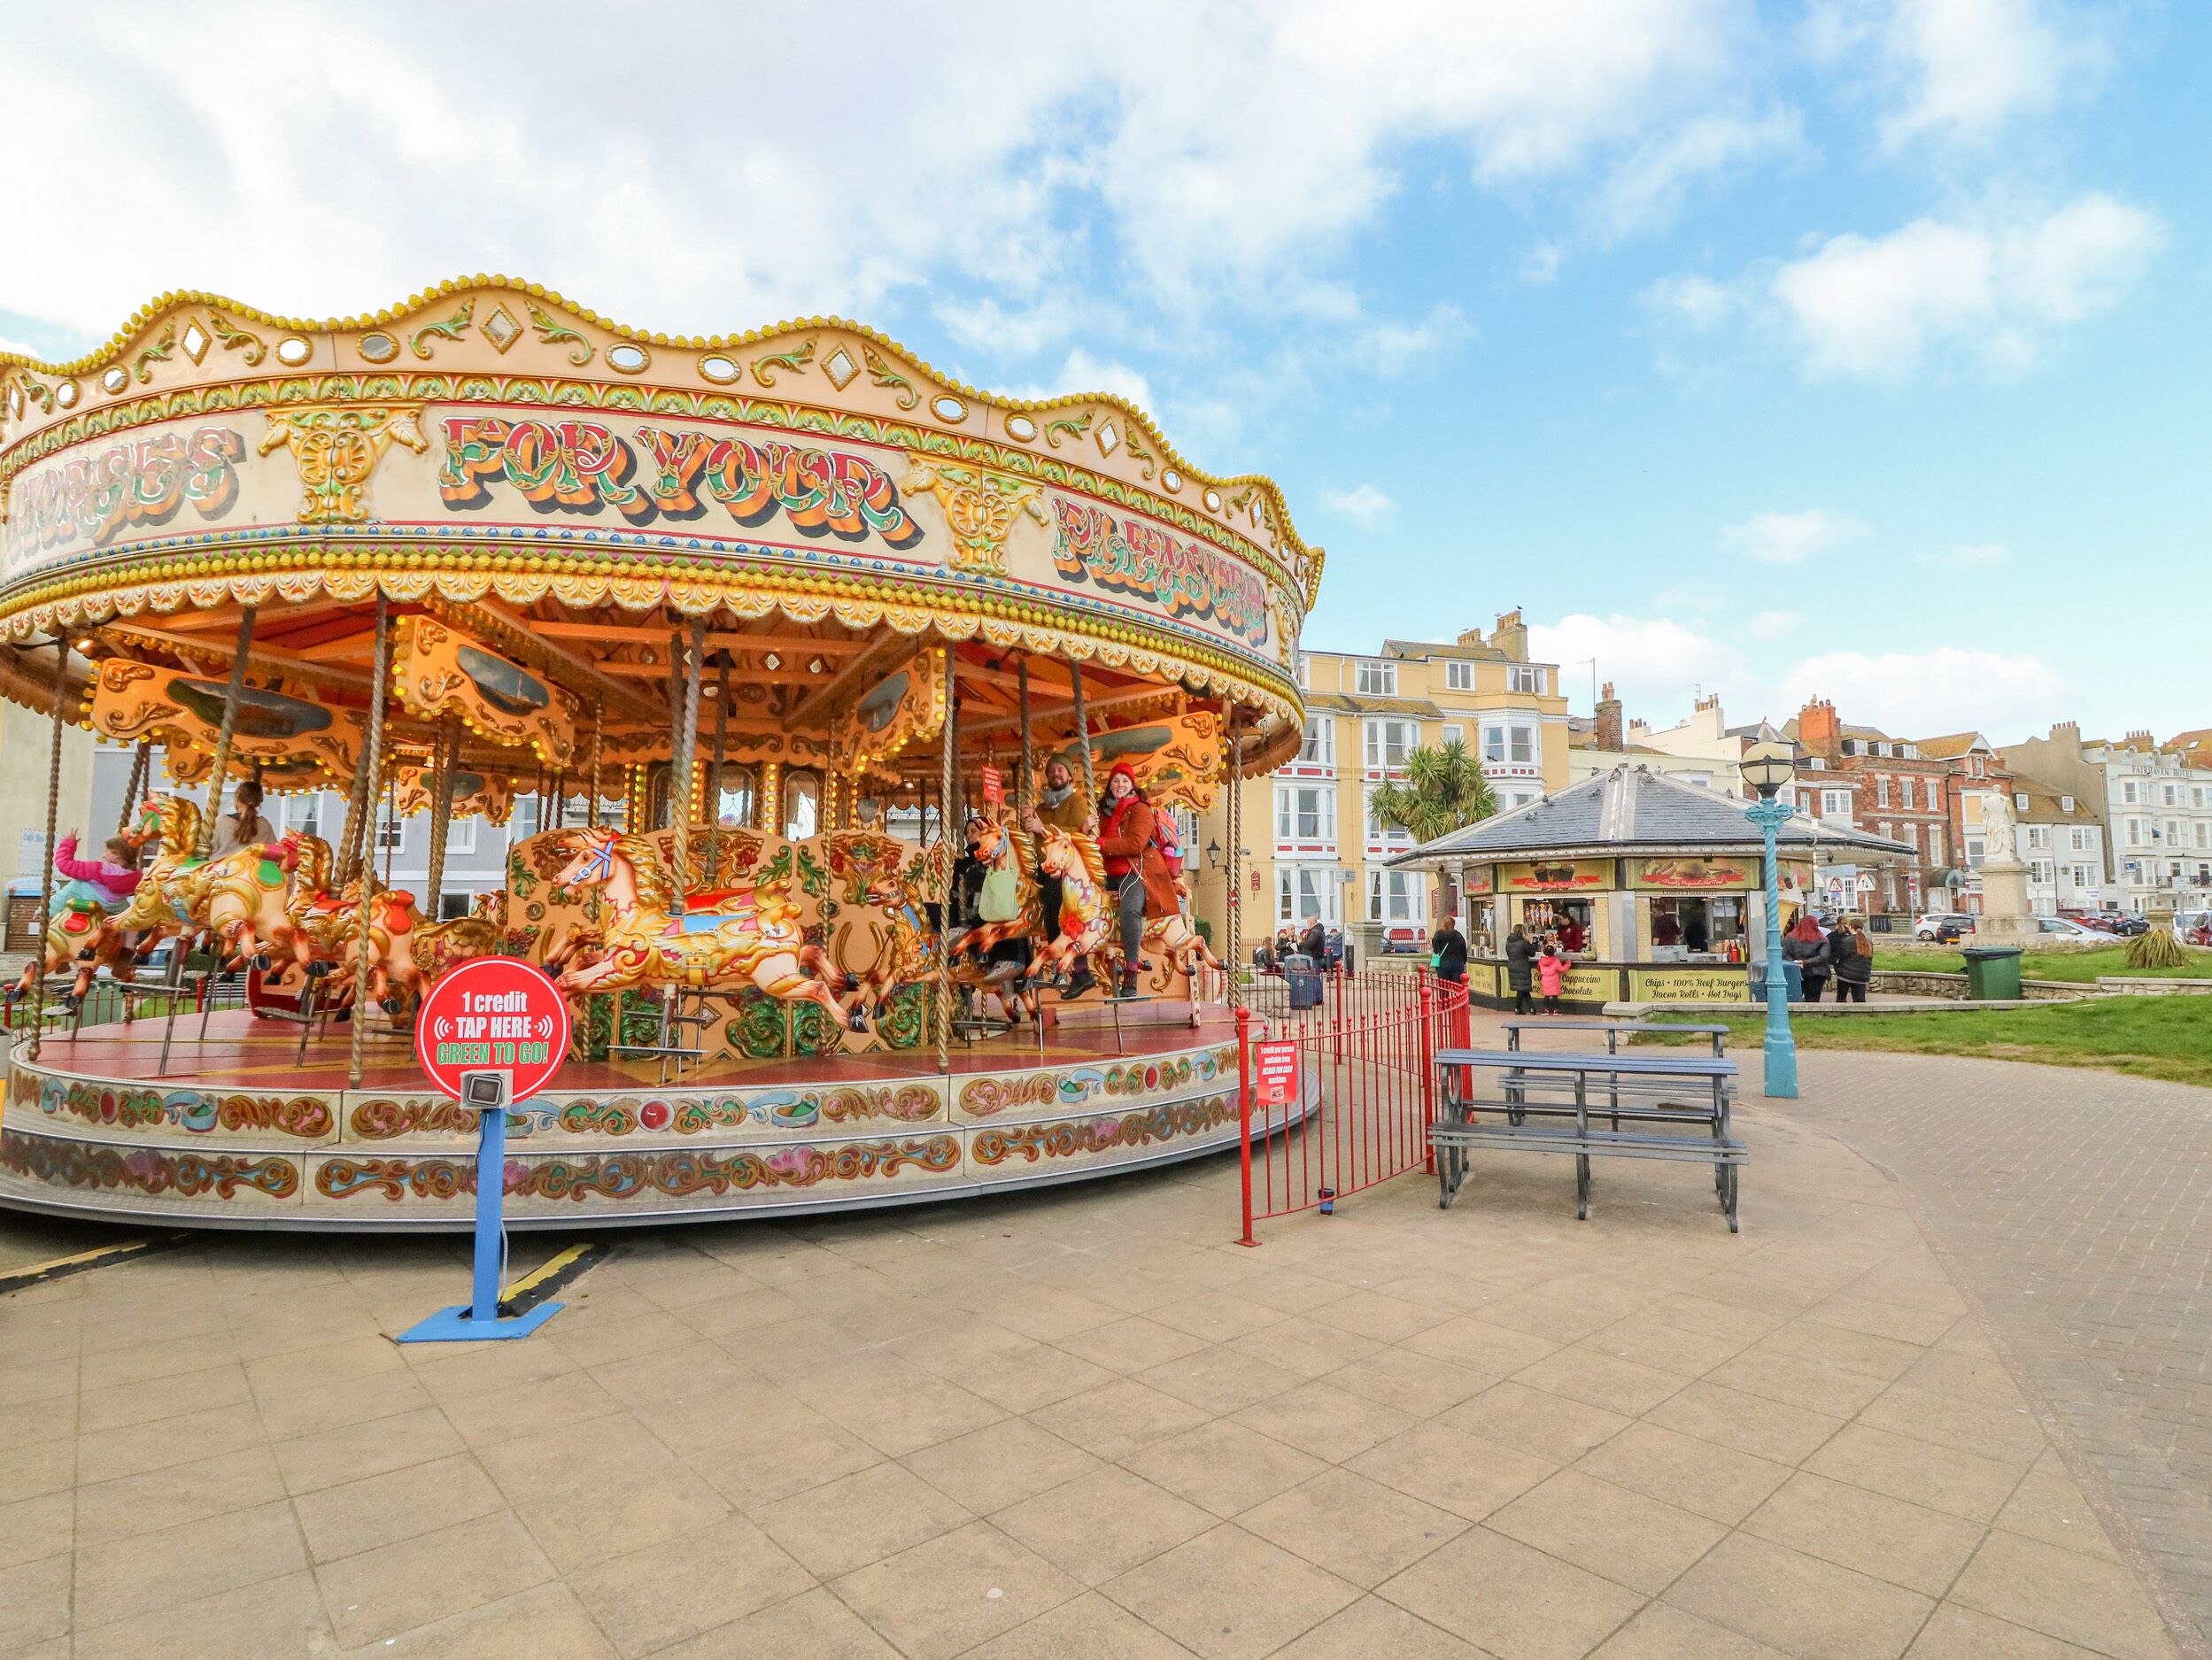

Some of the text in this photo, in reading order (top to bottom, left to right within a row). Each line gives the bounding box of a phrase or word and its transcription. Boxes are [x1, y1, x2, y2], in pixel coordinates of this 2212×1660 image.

[439, 416, 925, 549] FOR YOUR
[9, 426, 244, 563] HORSES
[1052, 495, 1267, 647] PLEASURE
[2131, 765, 2193, 778] FAIRHAVEN HOTEL
[1562, 973, 1601, 985] Cappuccino
[1645, 978, 1665, 990] Chips
[1674, 978, 1693, 987] 100%
[1696, 978, 1715, 989] Beef
[462, 991, 528, 1013] 1 credit
[1651, 989, 1742, 1000] Bacon Rolls Hot Dogs
[456, 1016, 532, 1039] TAP HERE
[437, 1041, 550, 1065] GREEN TO GO!
